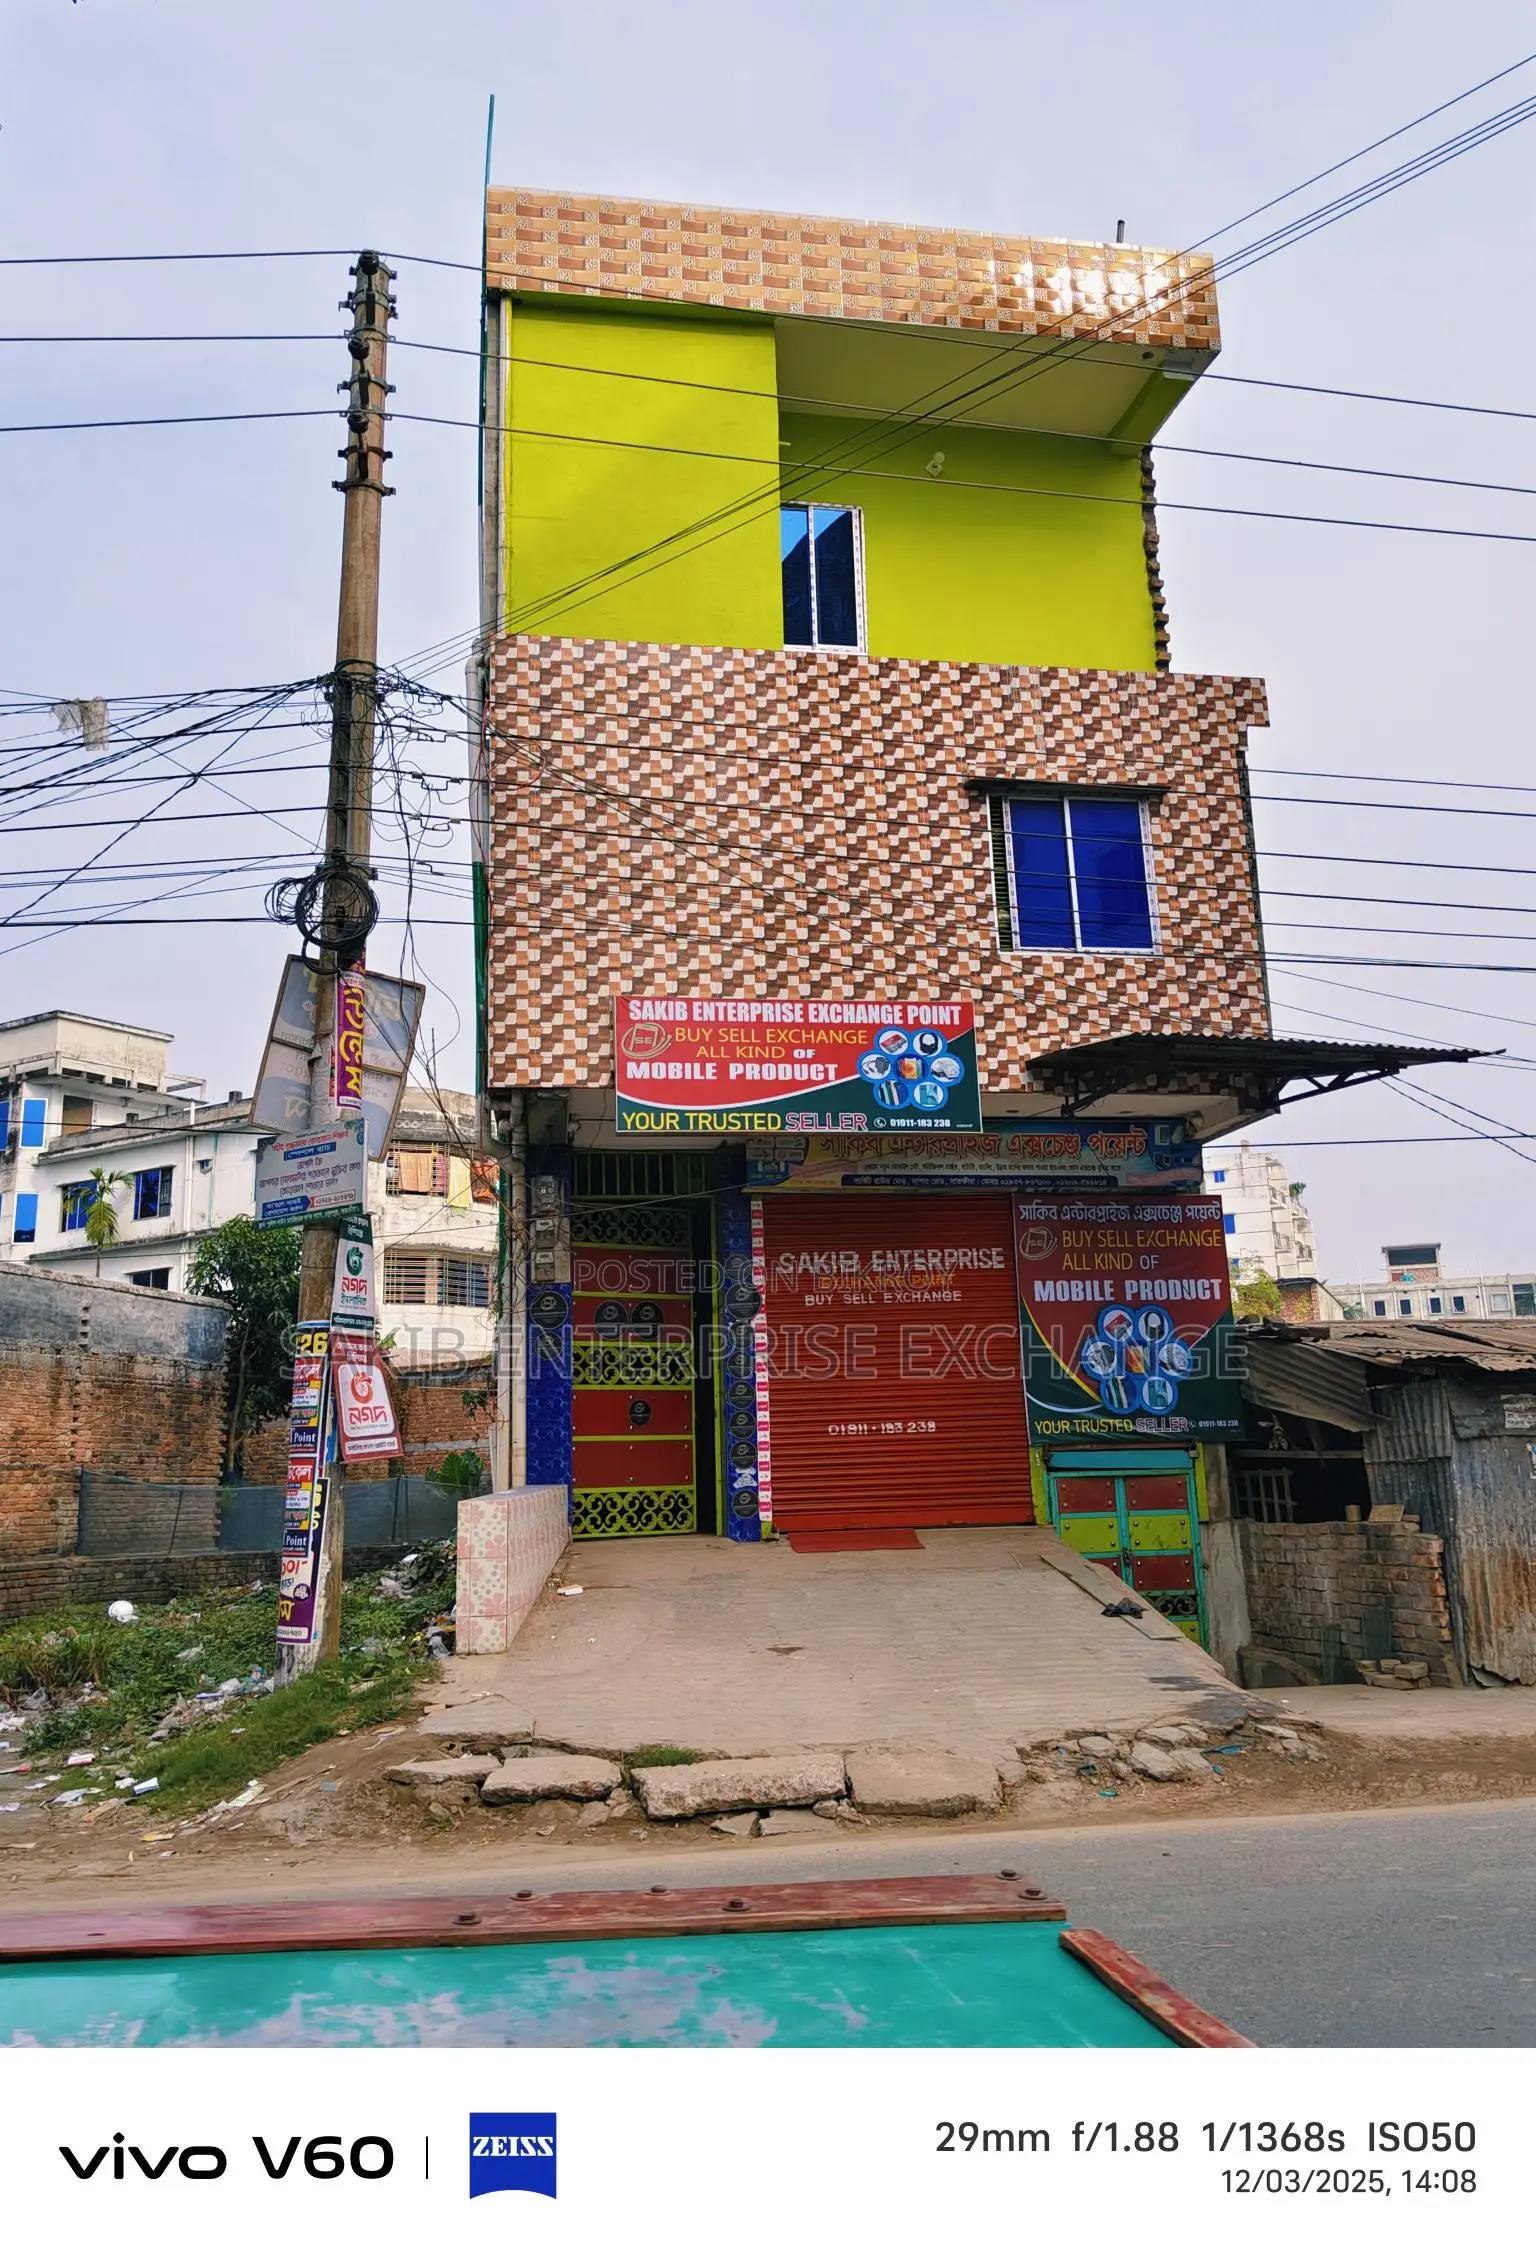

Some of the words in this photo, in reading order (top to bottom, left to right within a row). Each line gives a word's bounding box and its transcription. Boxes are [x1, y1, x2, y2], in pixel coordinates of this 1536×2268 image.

[628, 1000, 688, 1021] SAKIB
[692, 1001, 804, 1023] ENTERPRISE
[808, 1003, 904, 1025] EXCHANGE
[906, 1004, 962, 1026] POINT
[675, 1027, 713, 1042] BUY
[718, 1028, 761, 1043] SELL
[766, 1029, 868, 1045] EXCHANGE
[695, 1046, 730, 1058] ALL
[736, 1046, 786, 1059] KIND
[793, 1048, 816, 1060] OF
[626, 1061, 718, 1080] MOBILE
[729, 1063, 839, 1081] PRODUCT
[621, 1112, 680, 1130] YOUR
[684, 1112, 782, 1130] TRUSTED
[784, 1112, 869, 1132] SELLER
[1087, 1124, 1148, 1160] পয়েন্ট
[1018, 1199, 1058, 1220] সাকিব
[1060, 1201, 1131, 1223] এন্টারপ্রাইজ
[1133, 1204, 1183, 1224] এক্সচেঞ্জ
[1185, 1200, 1221, 1222] পয়েন্ট
[1062, 1229, 1094, 1248] BUY
[1097, 1229, 1134, 1248] SELL
[1136, 1229, 1223, 1247] EXCHANGE
[778, 1250, 860, 1274] SAKIB
[871, 1247, 1006, 1272] ENTERPRISE
[1062, 1252, 1092, 1270] ALL
[1094, 1252, 1134, 1270] KIND
[1139, 1255, 1160, 1270] OF
[341, 1277, 368, 1296] নগদ
[1033, 1279, 1115, 1302] MOBILE
[1124, 1278, 1223, 1302] PRODUCT
[804, 1294, 834, 1307] BUY
[843, 1292, 877, 1305] SELL
[883, 1290, 963, 1304] EXCHANGE
[348, 1406, 388, 1425] নগদ
[906, 1421, 936, 1433] 238
[1033, 1419, 1071, 1435] YOUR
[1072, 1418, 1134, 1434] TRUSTED
[1134, 1416, 1190, 1433] SELLER
[294, 1429, 316, 1443] Point
[286, 1531, 307, 1546] Point
